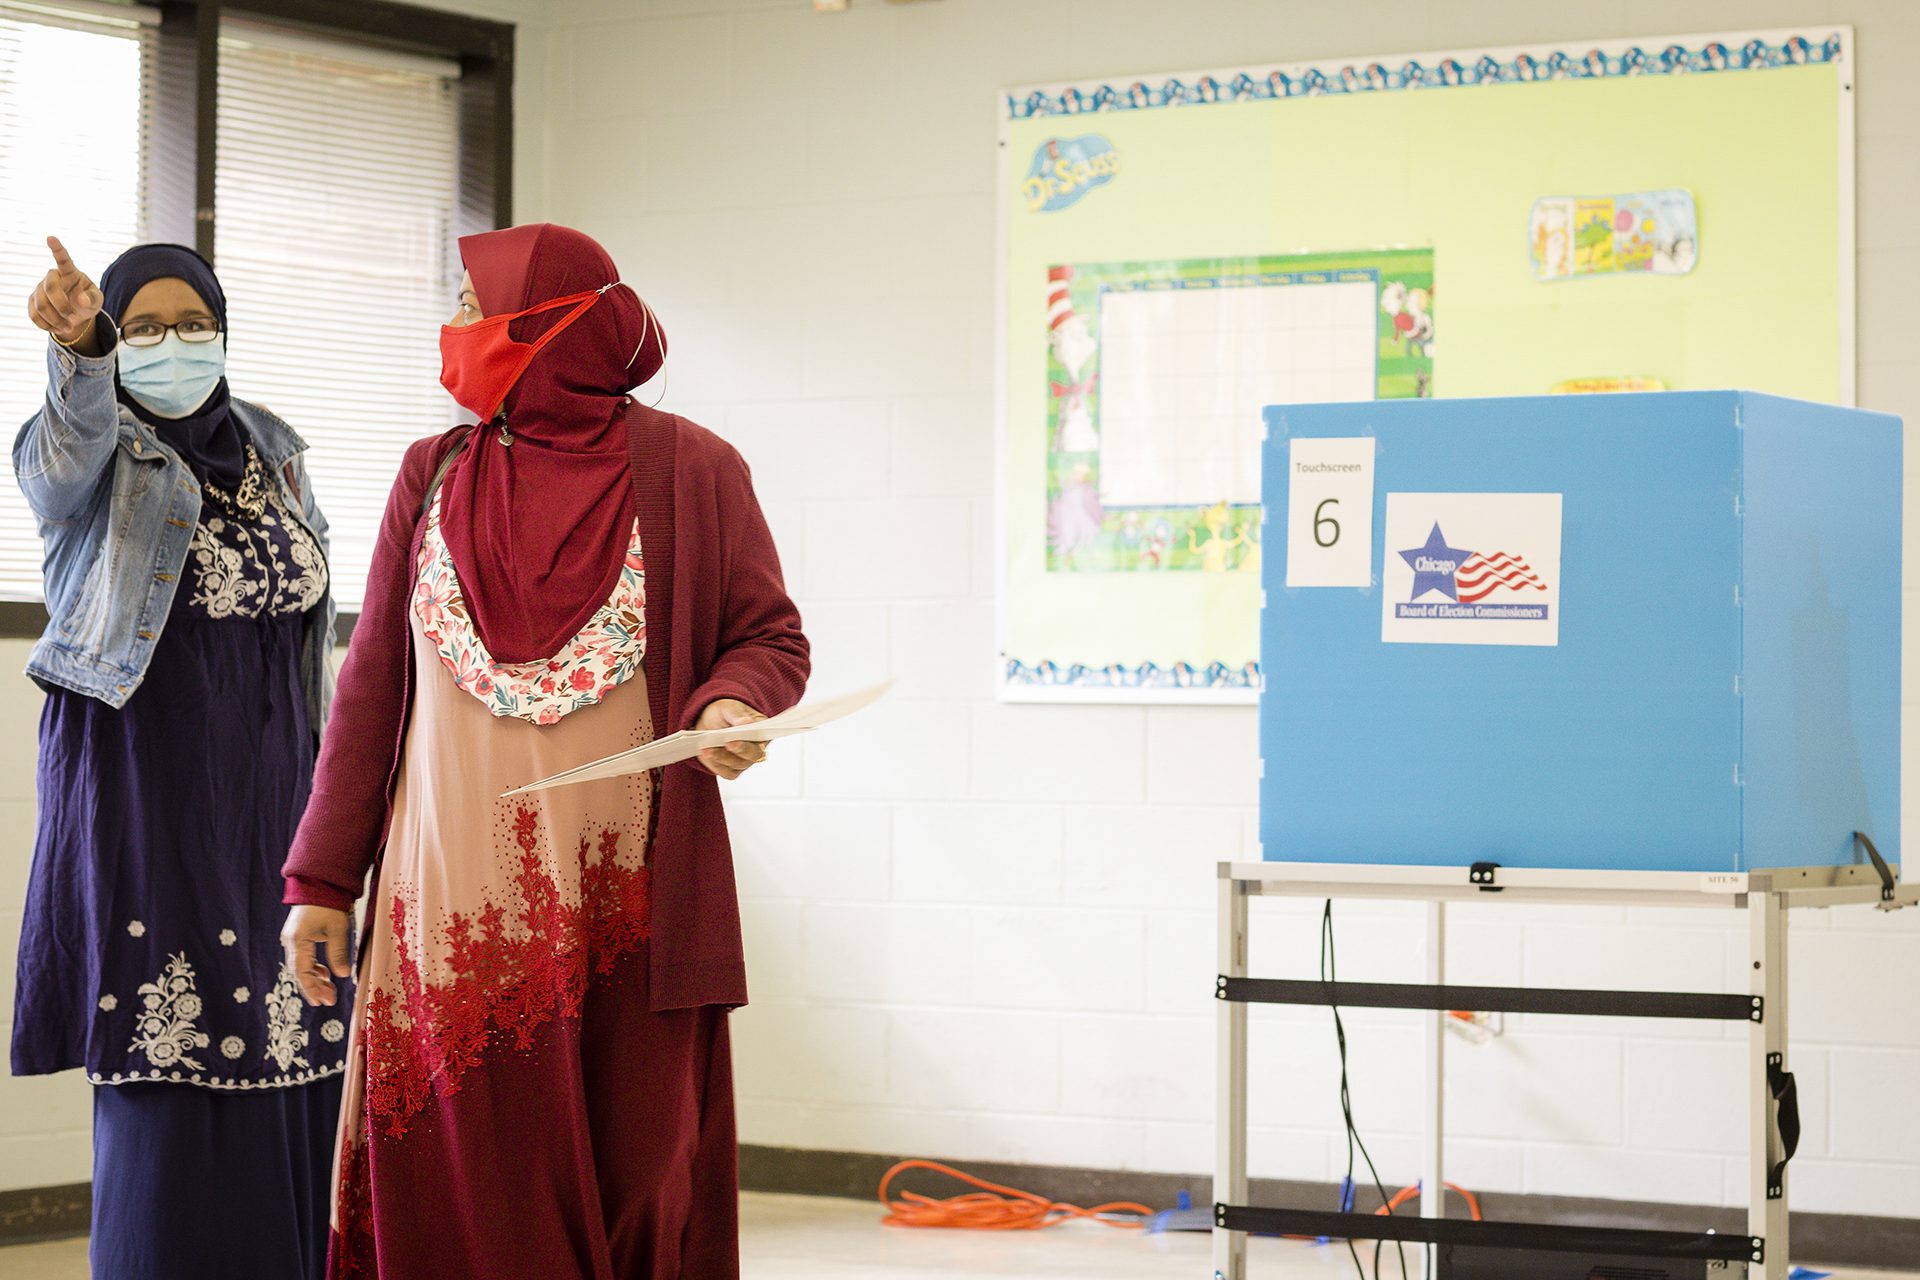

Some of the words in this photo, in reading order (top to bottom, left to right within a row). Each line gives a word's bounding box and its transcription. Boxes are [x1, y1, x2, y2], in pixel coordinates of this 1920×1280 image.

[1296, 461, 1362, 473] Touchscreen
[1313, 498, 1341, 547] 6
[1415, 555, 1456, 576] Chicago
[1399, 605, 1426, 617] Board
[1427, 605, 1438, 617] of
[1439, 605, 1474, 618] Election
[1475, 605, 1543, 618] Commissioners
